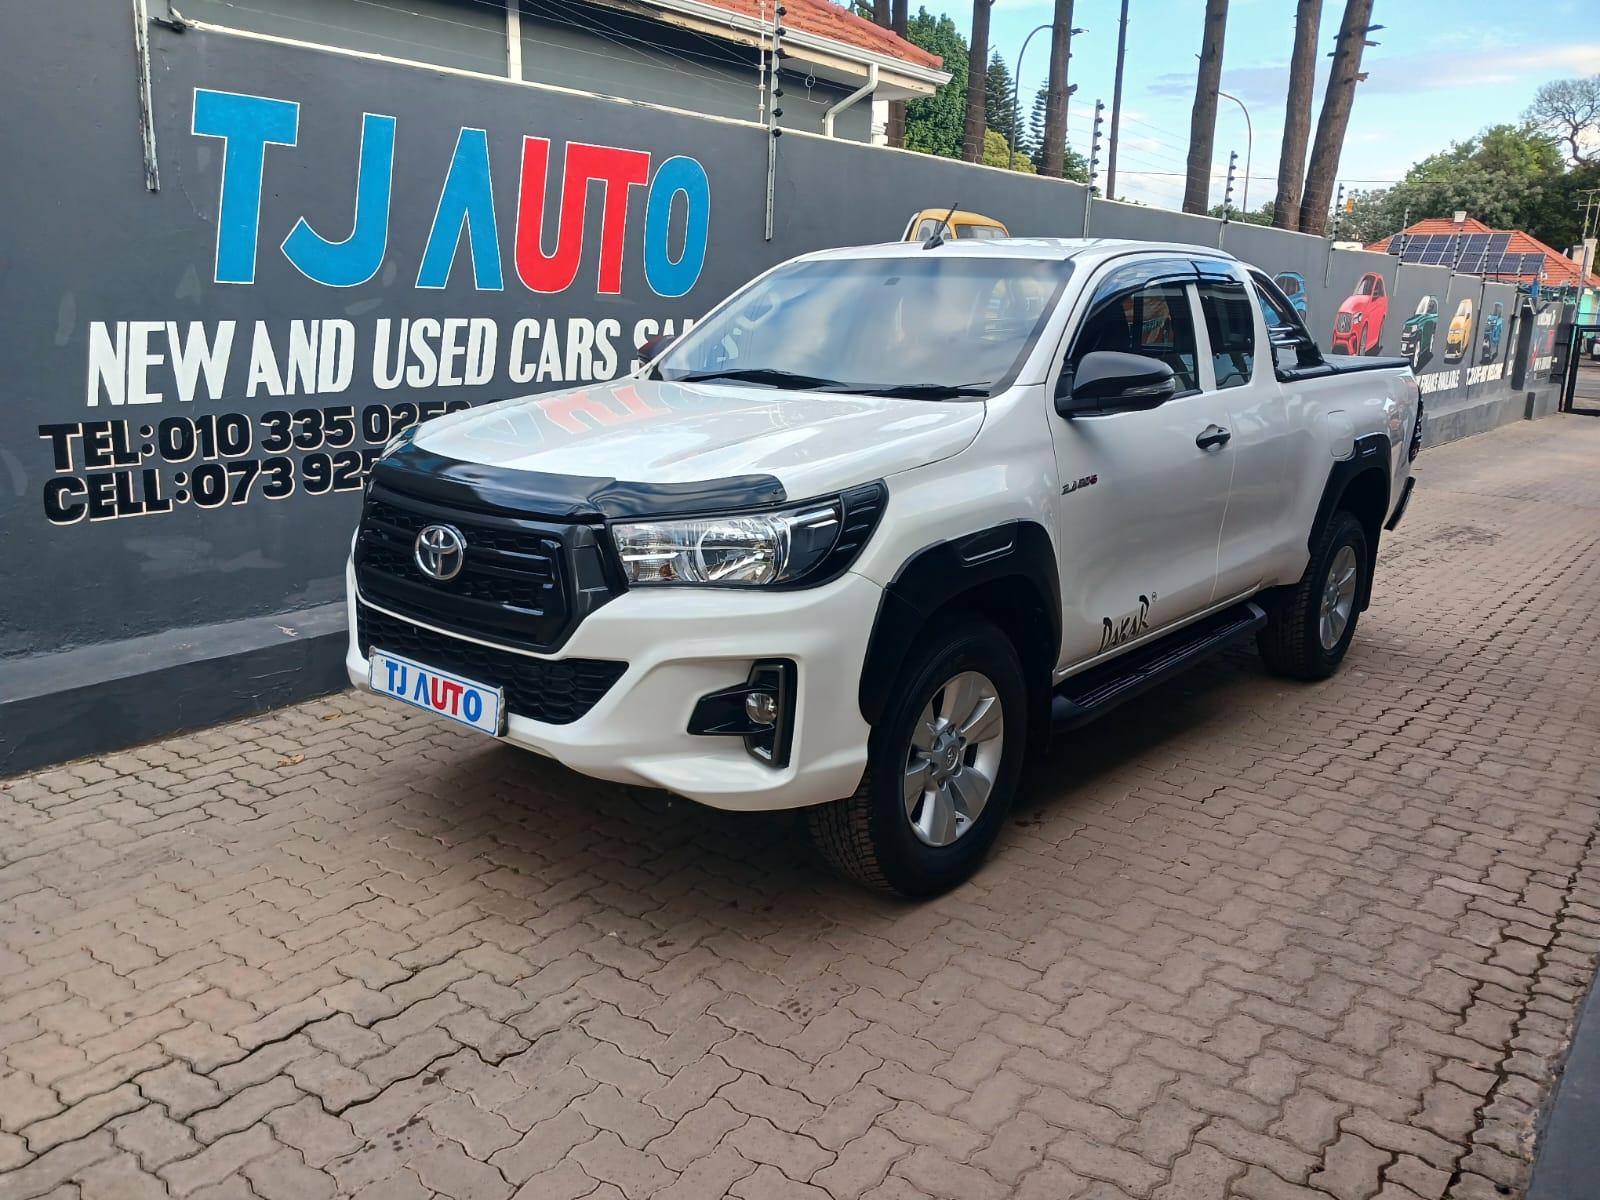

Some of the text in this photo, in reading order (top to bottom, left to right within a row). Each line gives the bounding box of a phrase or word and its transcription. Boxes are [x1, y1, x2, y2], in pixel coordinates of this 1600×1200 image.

[191, 87, 711, 298] TJ AUTO
[86, 320, 236, 407] NEW
[246, 318, 356, 399] AND
[372, 318, 498, 390] USED
[508, 318, 621, 383] CARS
[259, 406, 356, 455] 335
[385, 659, 483, 723] TJ AUTO
